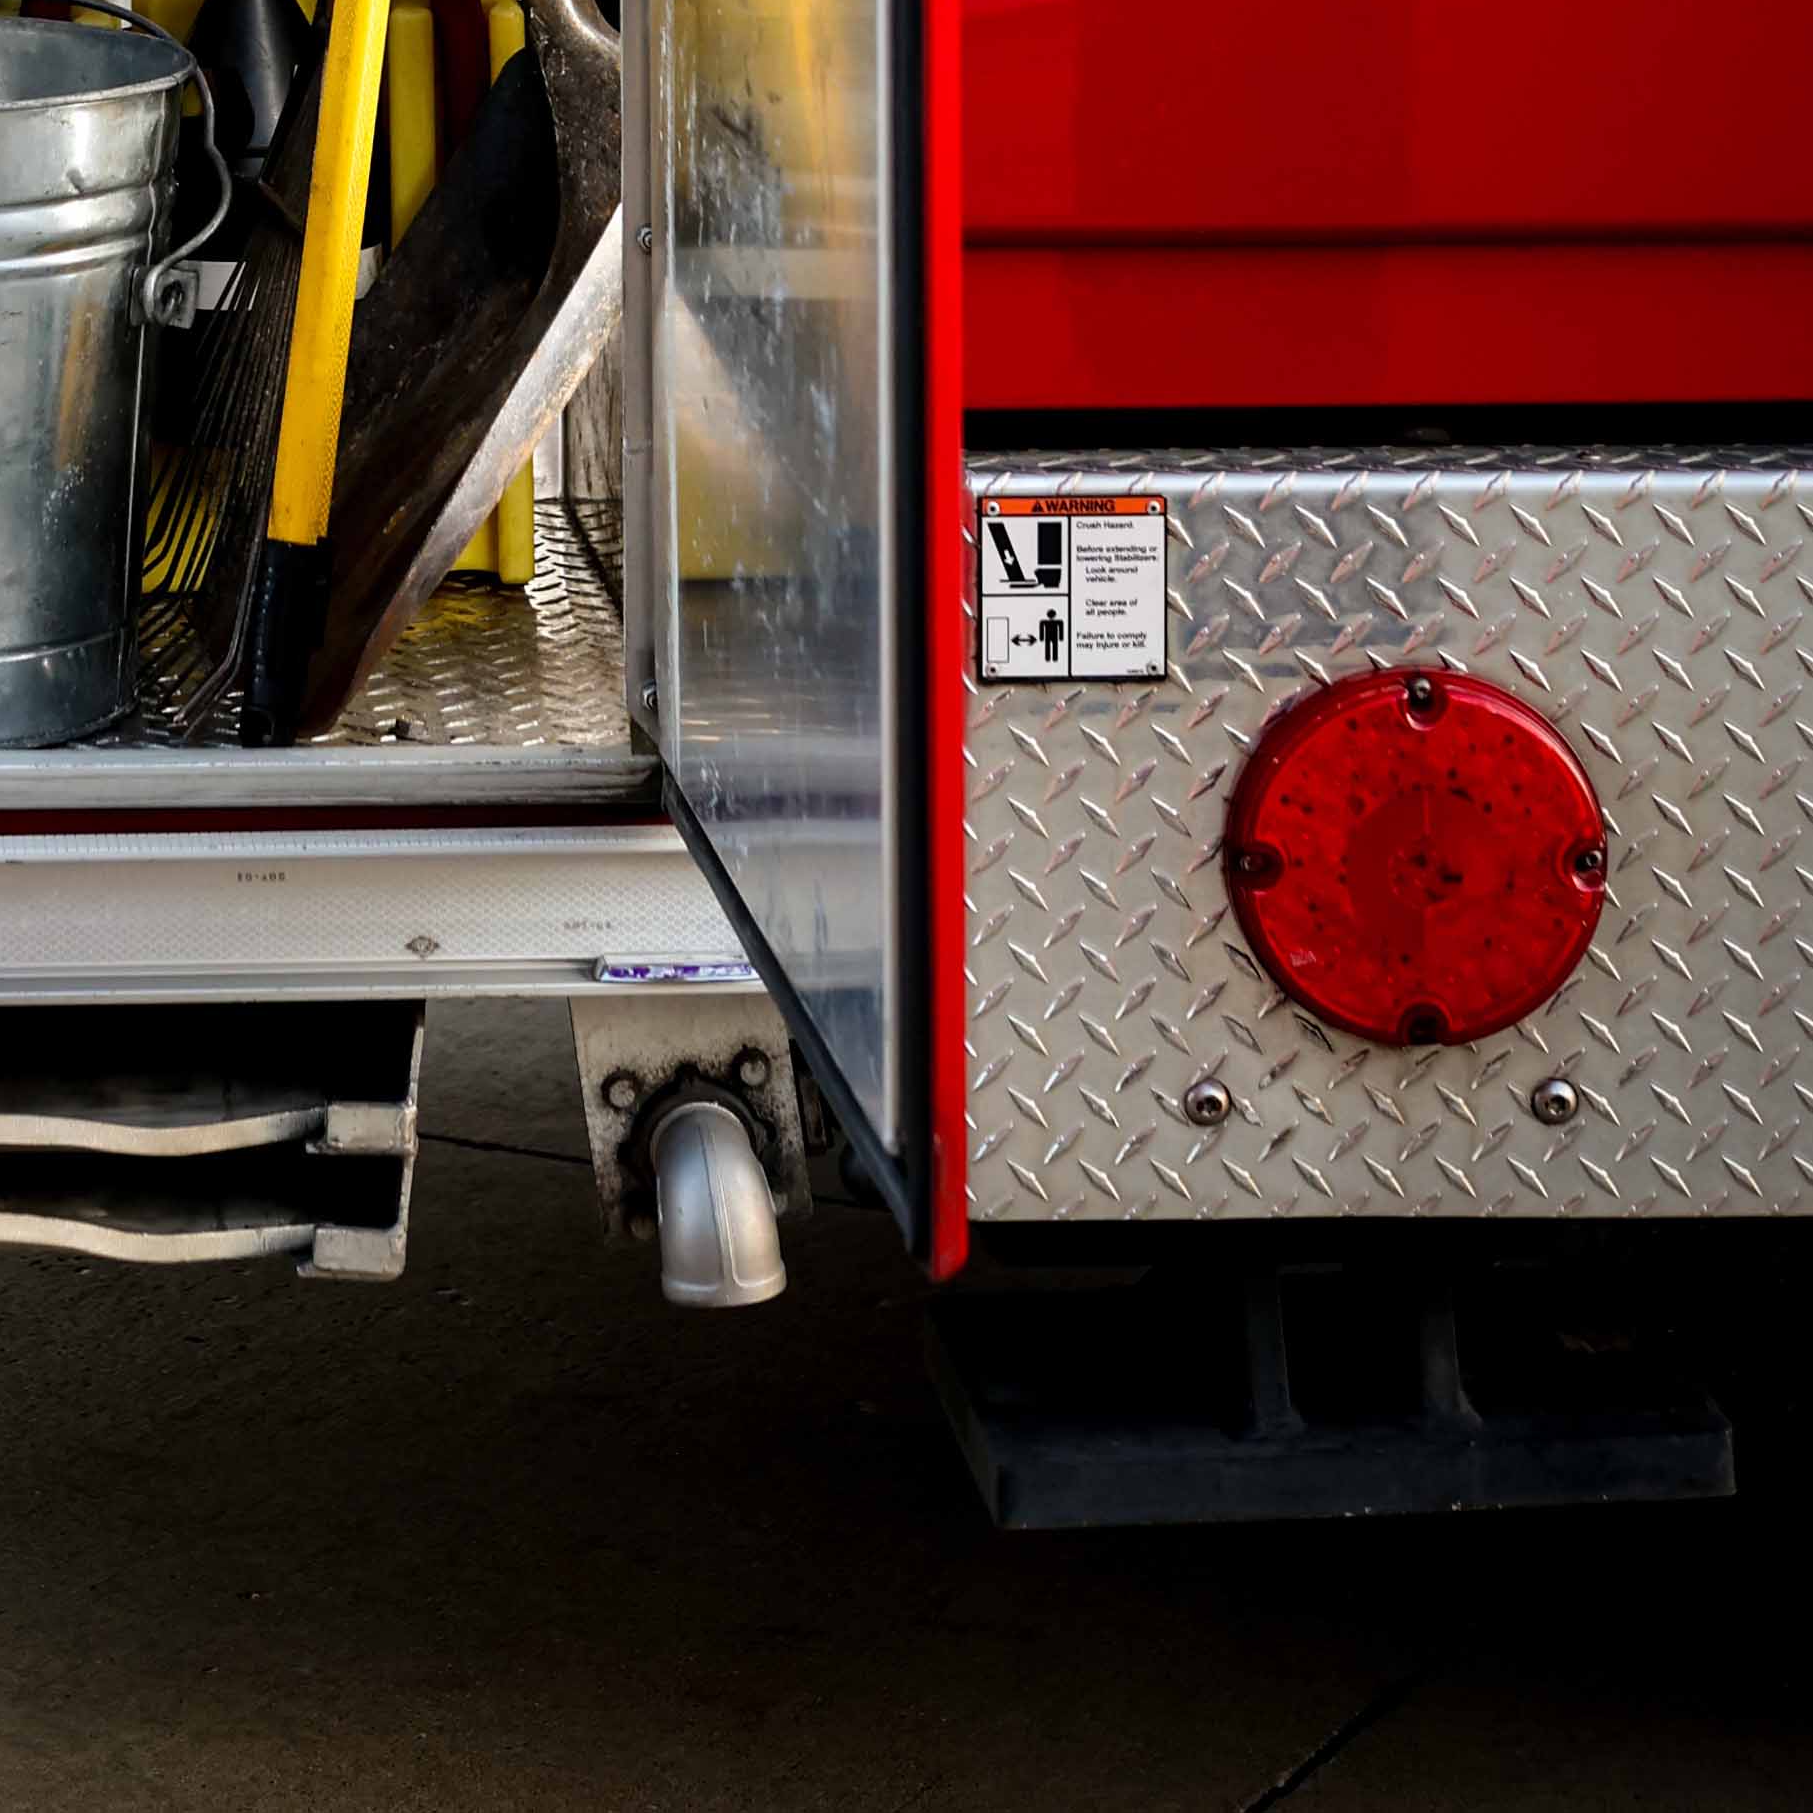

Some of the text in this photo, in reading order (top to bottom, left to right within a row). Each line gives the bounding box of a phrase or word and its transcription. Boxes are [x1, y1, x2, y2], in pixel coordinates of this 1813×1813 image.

[1044, 499, 1116, 513] WARNING
[1076, 544, 1104, 553] Before
[1105, 545, 1147, 554] extending
[1085, 565, 1138, 574] Look around
[1085, 598, 1138, 607] Clear area of
[1085, 607, 1096, 616] all
[1076, 631, 1148, 641] Failure to comply
[1076, 642, 1094, 650] may
